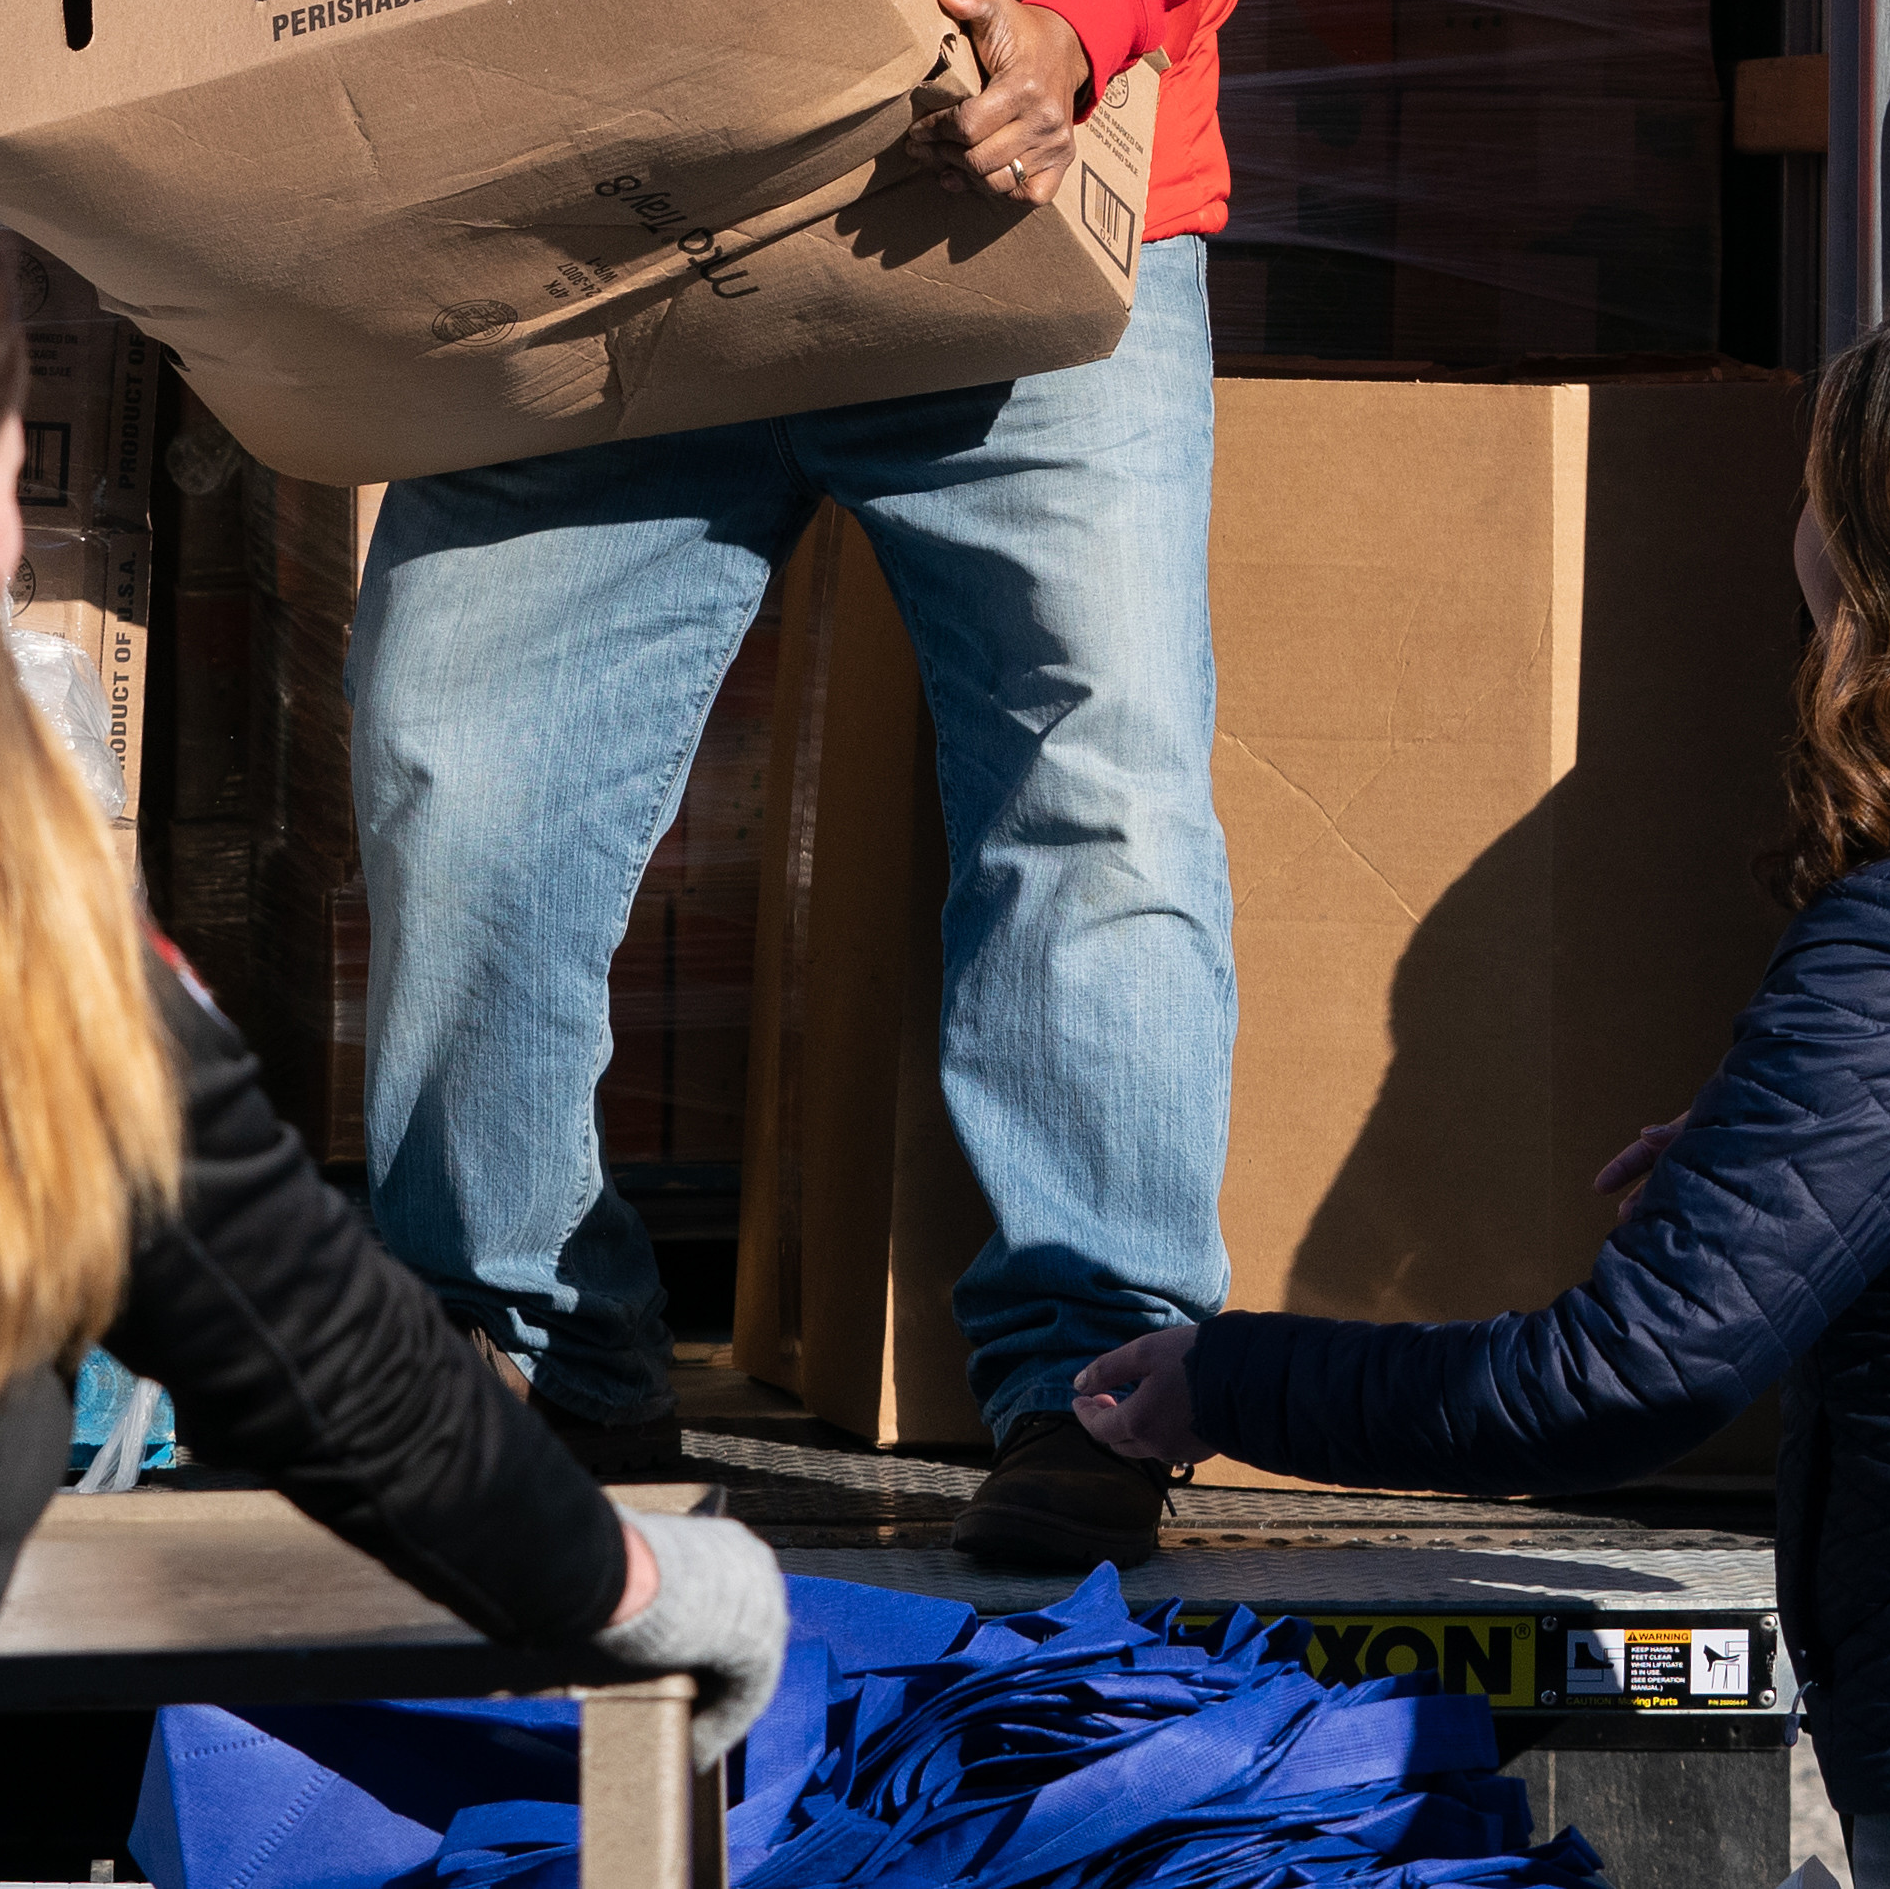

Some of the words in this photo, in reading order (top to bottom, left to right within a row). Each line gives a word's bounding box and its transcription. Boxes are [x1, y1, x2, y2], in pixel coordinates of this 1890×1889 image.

[128, 333, 145, 365] OF
[118, 369, 143, 490] PRODUCT
[116, 551, 136, 622] U.S.A.
[116, 632, 132, 664] OF
[1310, 1625, 1511, 1695] XON
